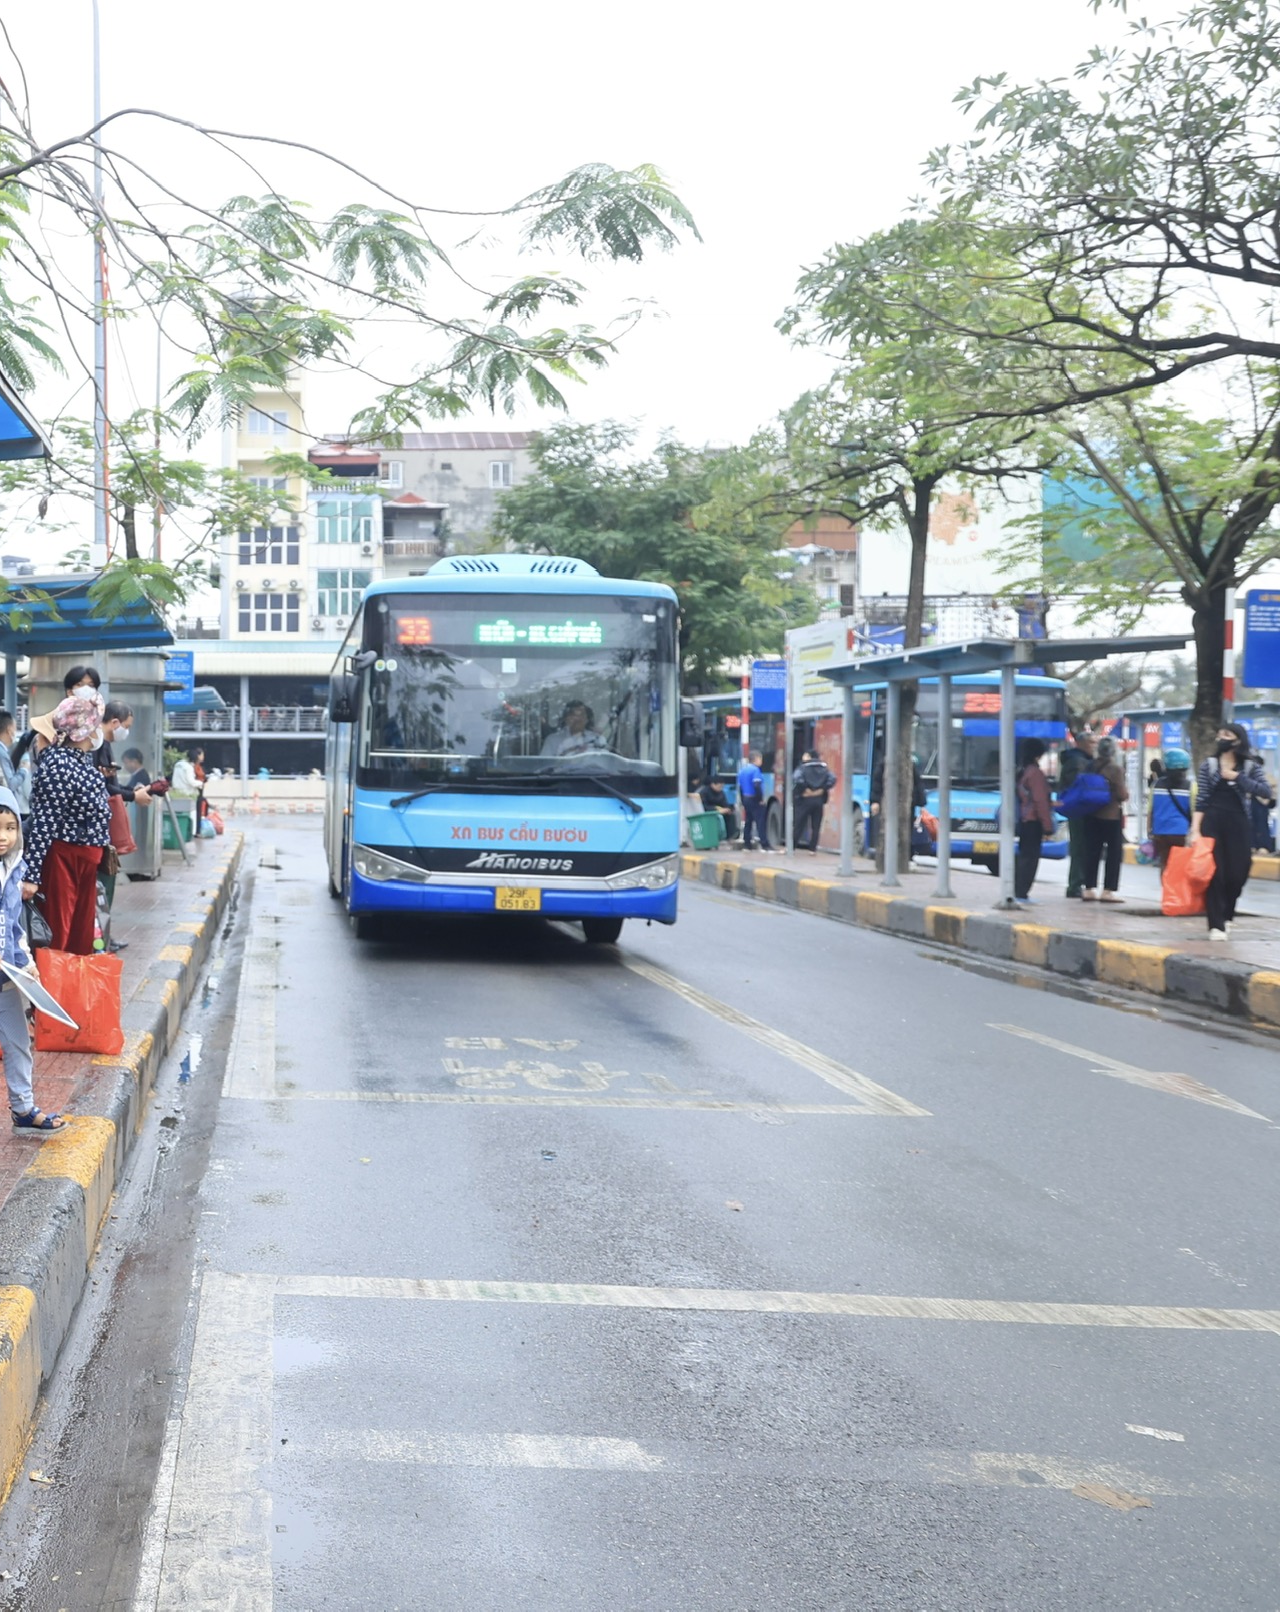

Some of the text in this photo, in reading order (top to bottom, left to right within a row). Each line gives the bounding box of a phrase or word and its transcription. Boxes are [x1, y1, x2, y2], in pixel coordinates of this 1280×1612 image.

[478, 828, 505, 840] BUS
[466, 852, 573, 871] HANOIBUS
[509, 889, 526, 898] 29F
